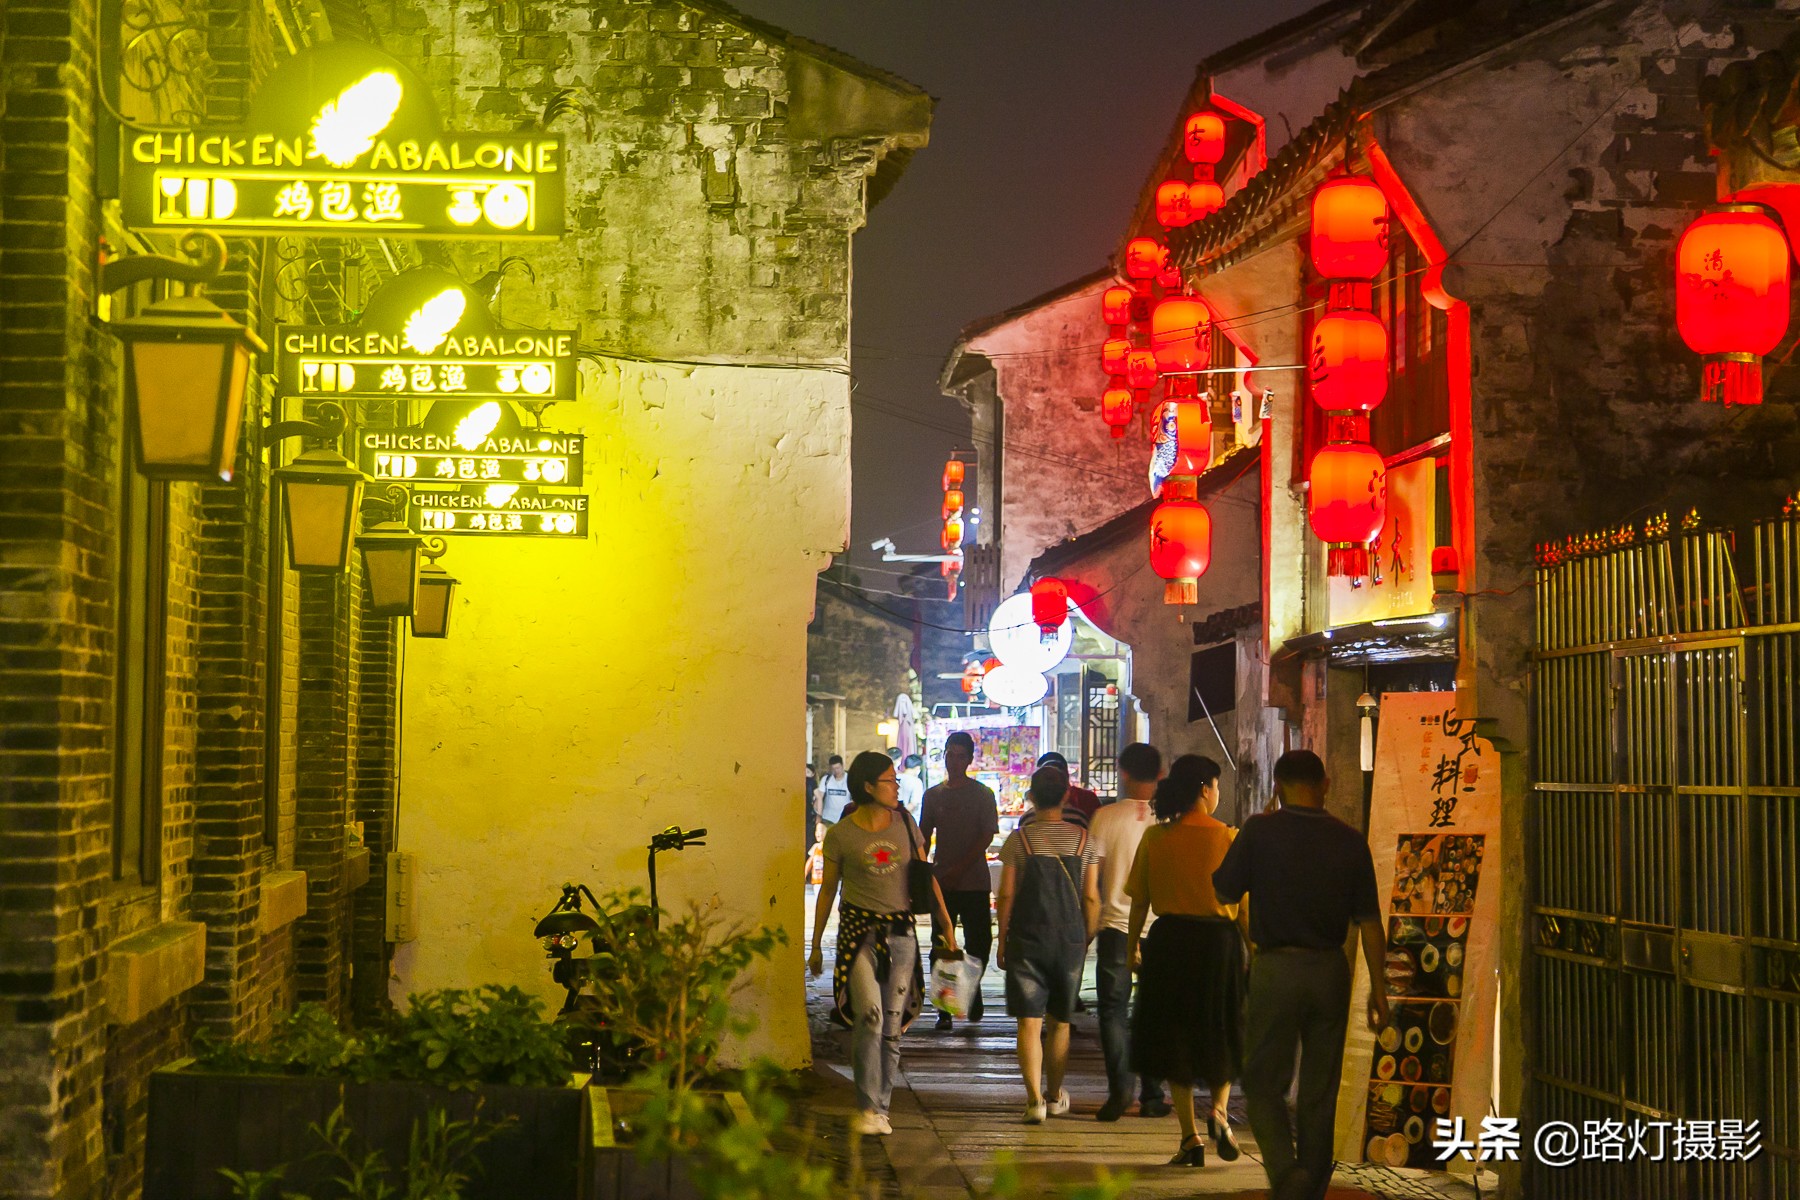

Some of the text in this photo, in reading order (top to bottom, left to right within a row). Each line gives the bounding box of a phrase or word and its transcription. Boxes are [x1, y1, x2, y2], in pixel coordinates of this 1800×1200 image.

[132, 133, 559, 173] CHICKEN ABALONE
[273, 180, 404, 223] 鸡包渔
[284, 333, 572, 358] CHICKEN ABALONE
[379, 363, 468, 393] 鸡包渔
[363, 433, 581, 455] CHICKEN ABALONE
[434, 457, 501, 480] 鸡包渔
[412, 494, 587, 511] CHICKEN ABALONE
